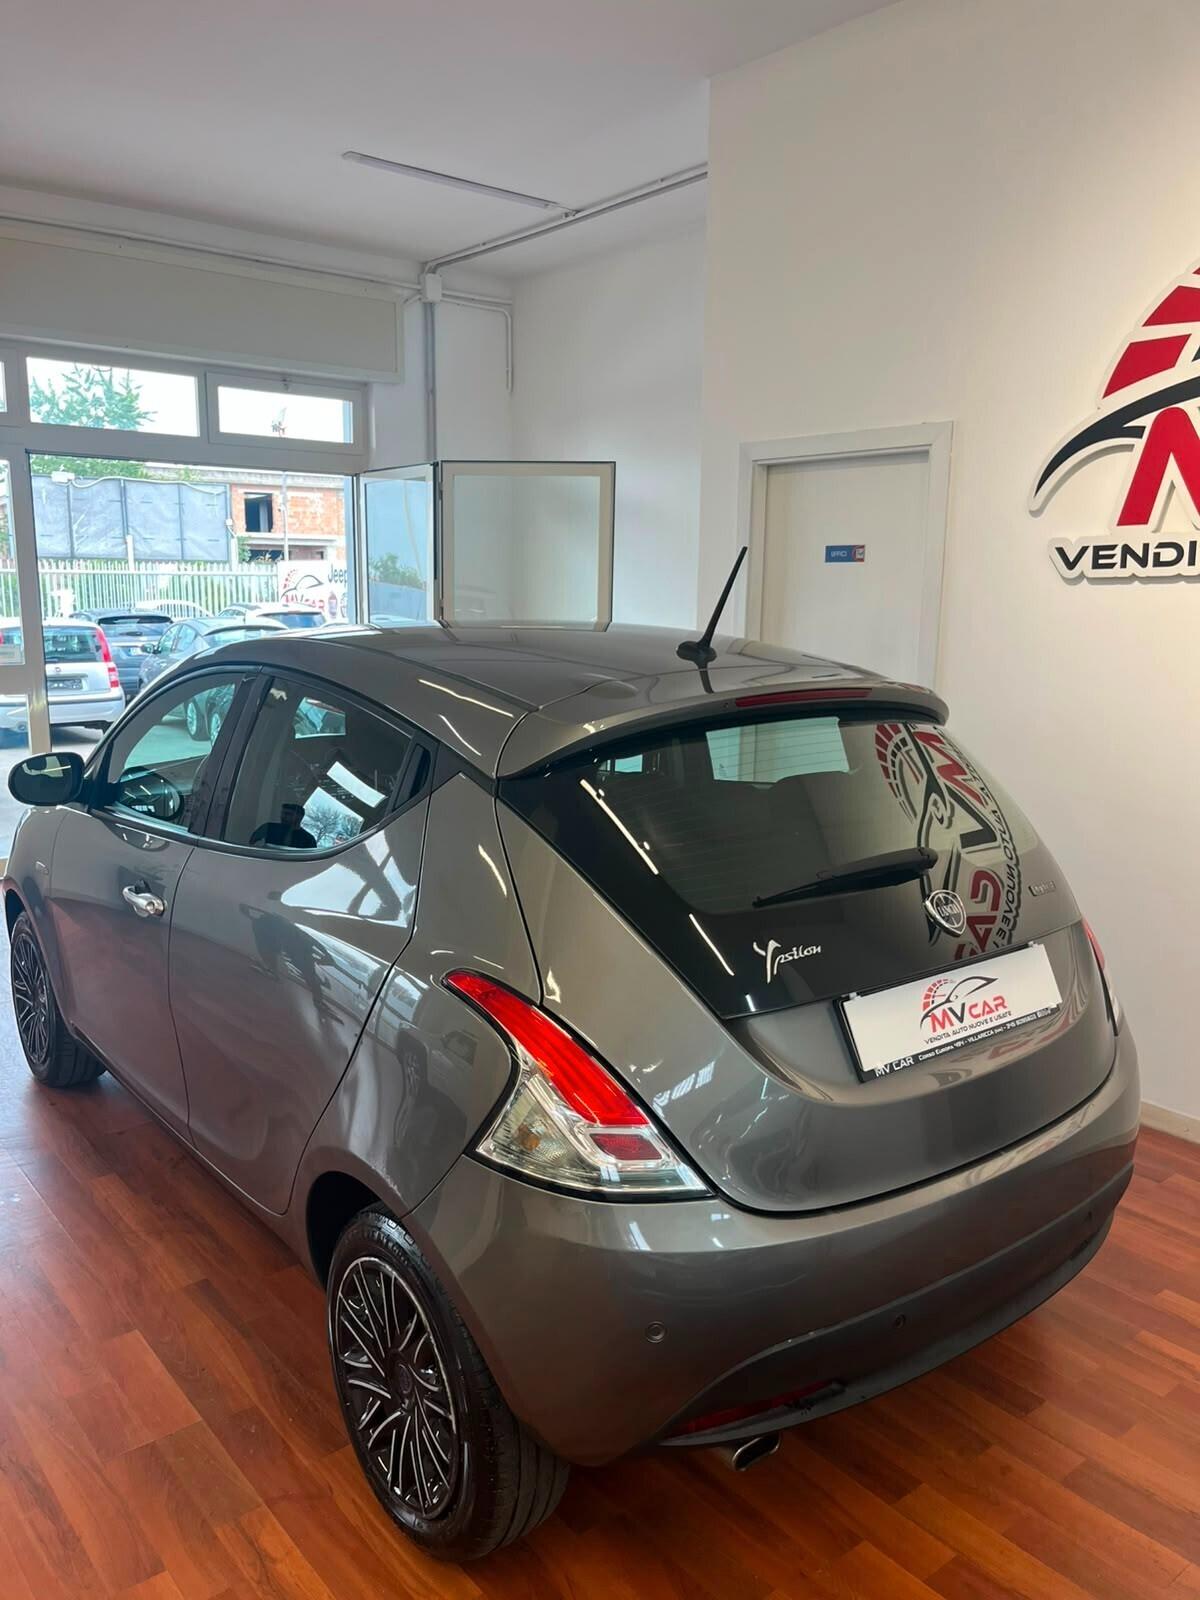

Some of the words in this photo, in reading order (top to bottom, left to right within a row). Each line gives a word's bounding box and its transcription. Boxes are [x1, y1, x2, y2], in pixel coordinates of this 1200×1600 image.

[1054, 540, 1198, 571] VENDI
[753, 939, 821, 984] Ypsilon
[924, 1031, 951, 1045] VENDITA
[952, 1025, 968, 1036] AUTO
[968, 1018, 988, 1031] NUOVE
[875, 1063, 890, 1077] MV
[892, 1056, 914, 1071] CAR
